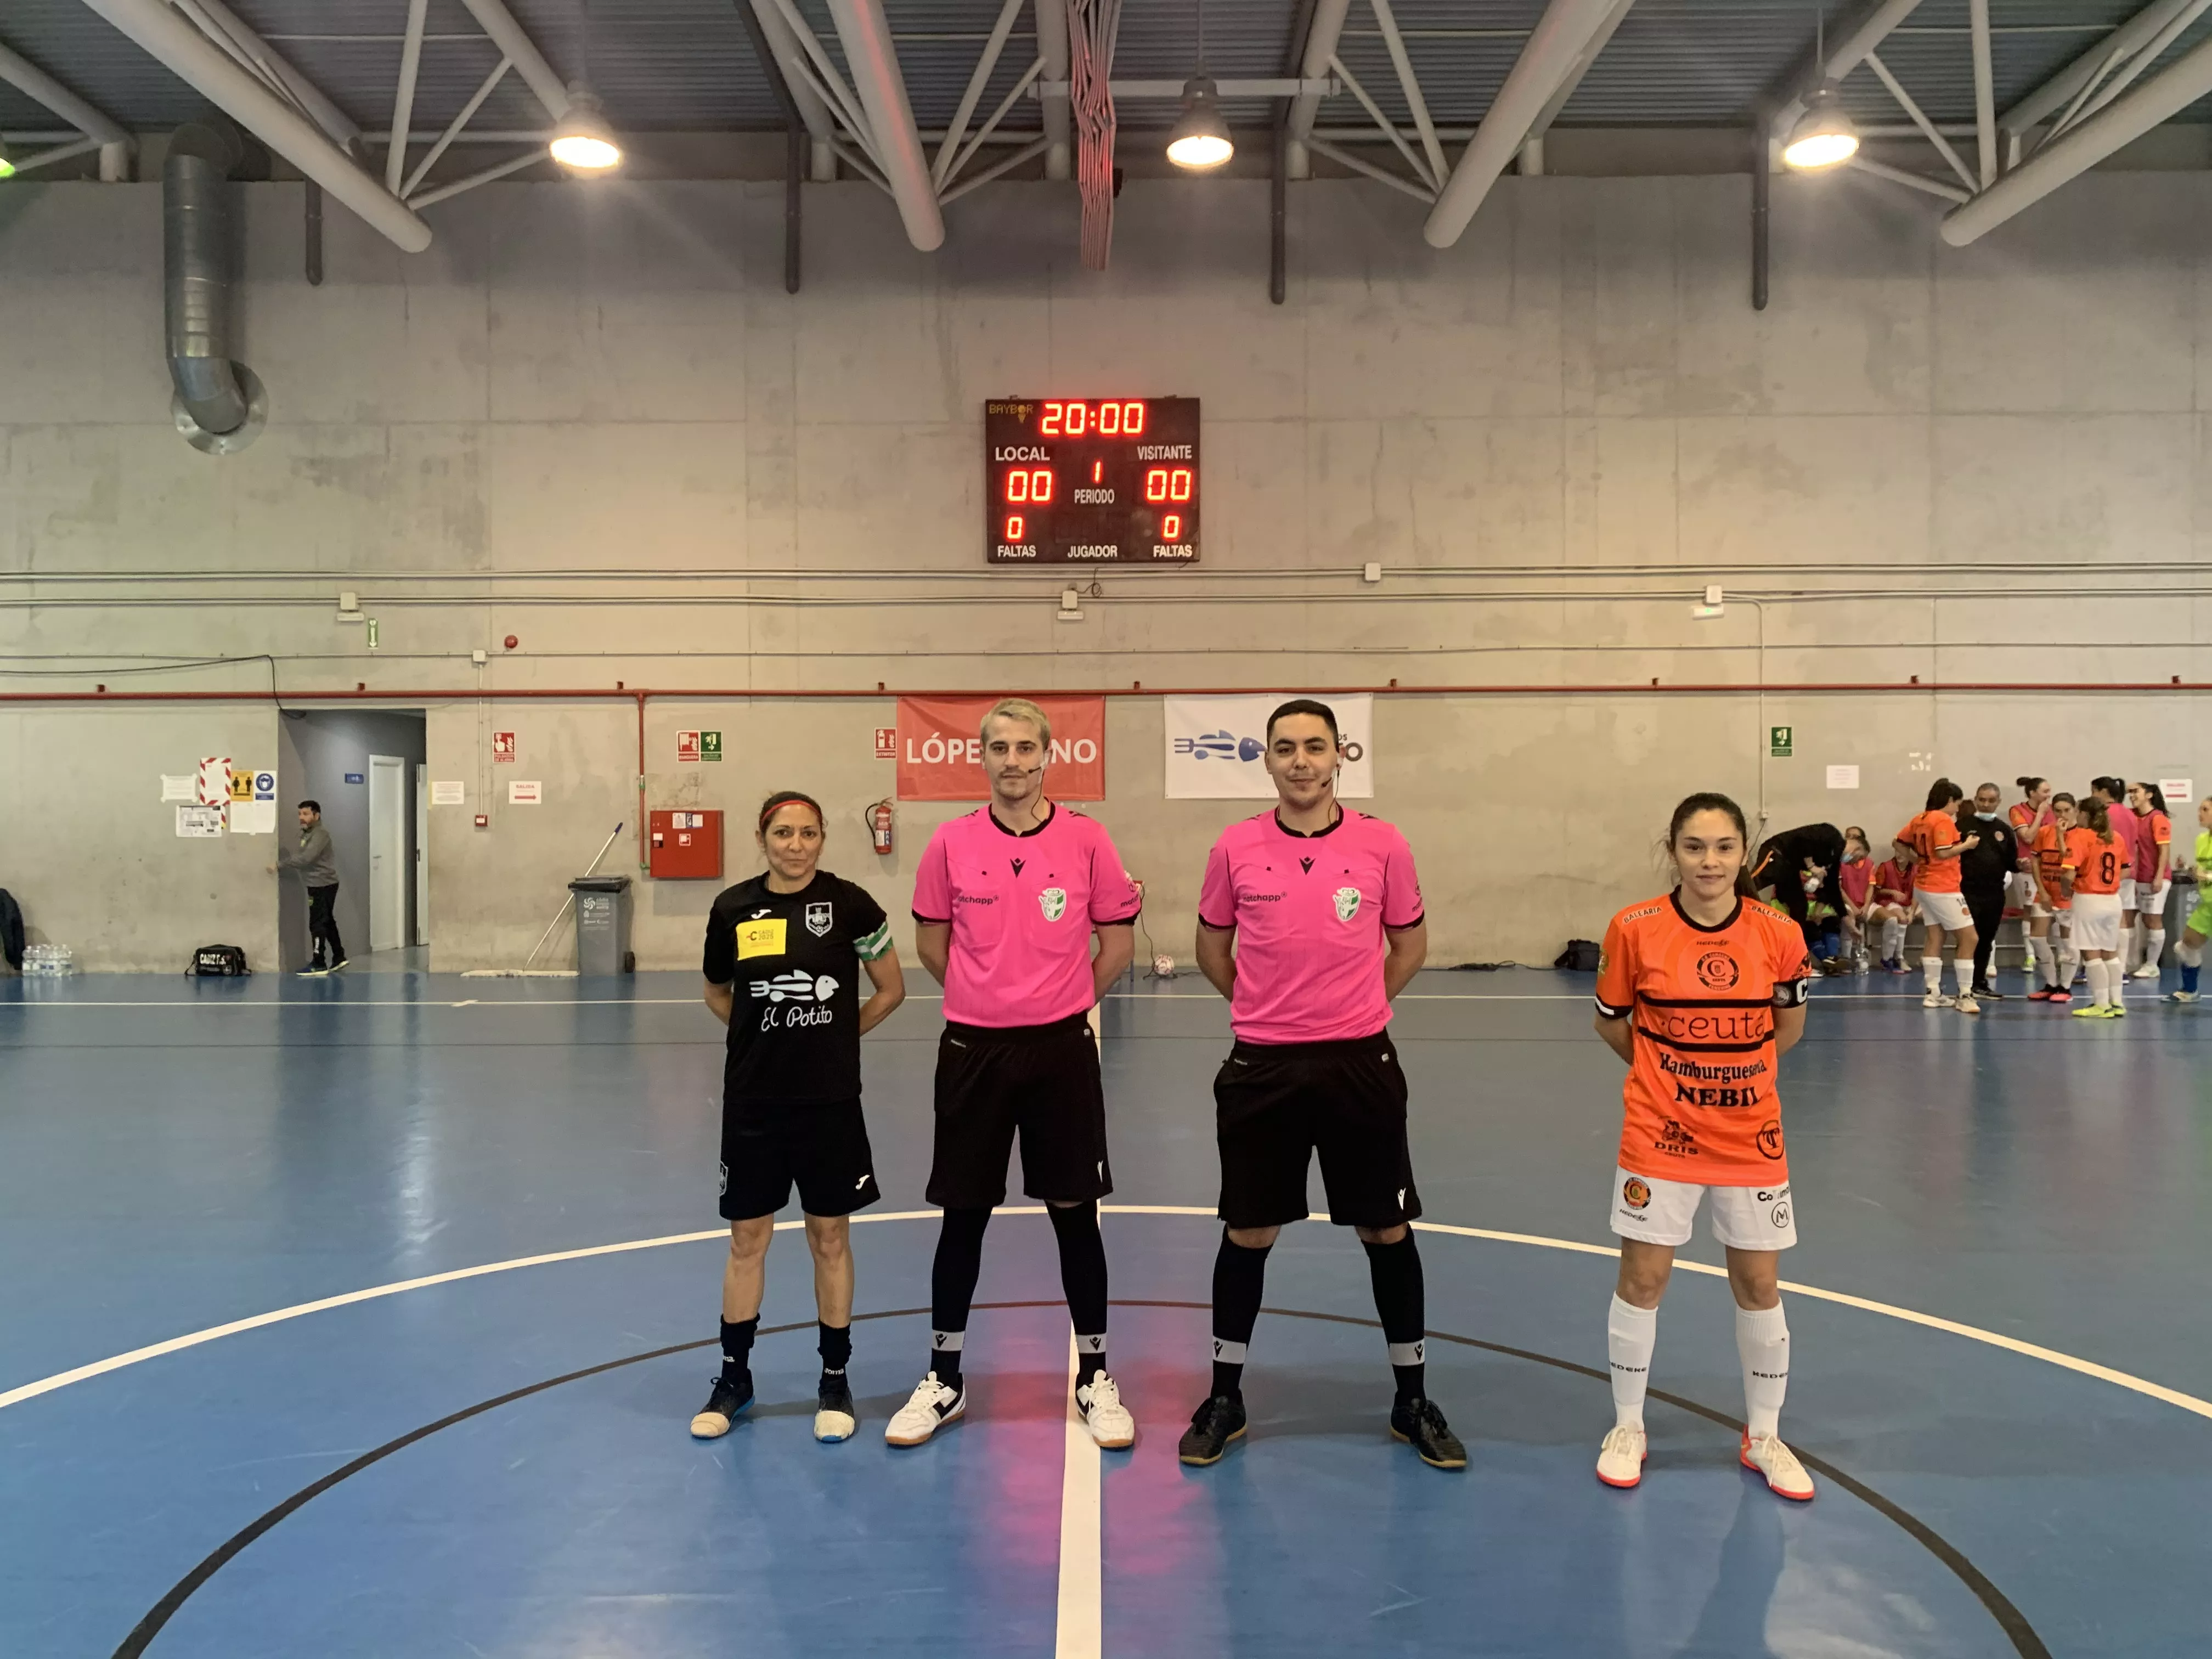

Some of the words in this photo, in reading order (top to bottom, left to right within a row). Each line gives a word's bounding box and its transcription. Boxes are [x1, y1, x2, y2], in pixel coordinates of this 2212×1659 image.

[1042, 403, 1144, 435] 20:00
[995, 447, 1050, 461] LOCAL
[1137, 445, 1192, 460] VISITANTE
[1094, 461, 1101, 483] 1
[1007, 471, 1052, 501] 00
[1074, 489, 1115, 504] PERIODO
[1147, 470, 1192, 501] 00
[1007, 517, 1023, 539] 0
[1163, 516, 1180, 538] 0
[997, 545, 1036, 557] FALTAS
[1068, 545, 1118, 558] JUGADOR
[1153, 545, 1192, 557] FALTAS
[907, 731, 981, 764] LÓPE
[2101, 852, 2115, 884] 8
[1623, 906, 1662, 924] BALEARIA
[1751, 905, 1792, 925] BALEARIA
[1796, 978, 1808, 1003] C
[761, 1007, 779, 1032] El
[786, 1005, 833, 1028] Potito
[1668, 1012, 1765, 1039] ceuta
[1655, 1141, 1699, 1155] DRIS
